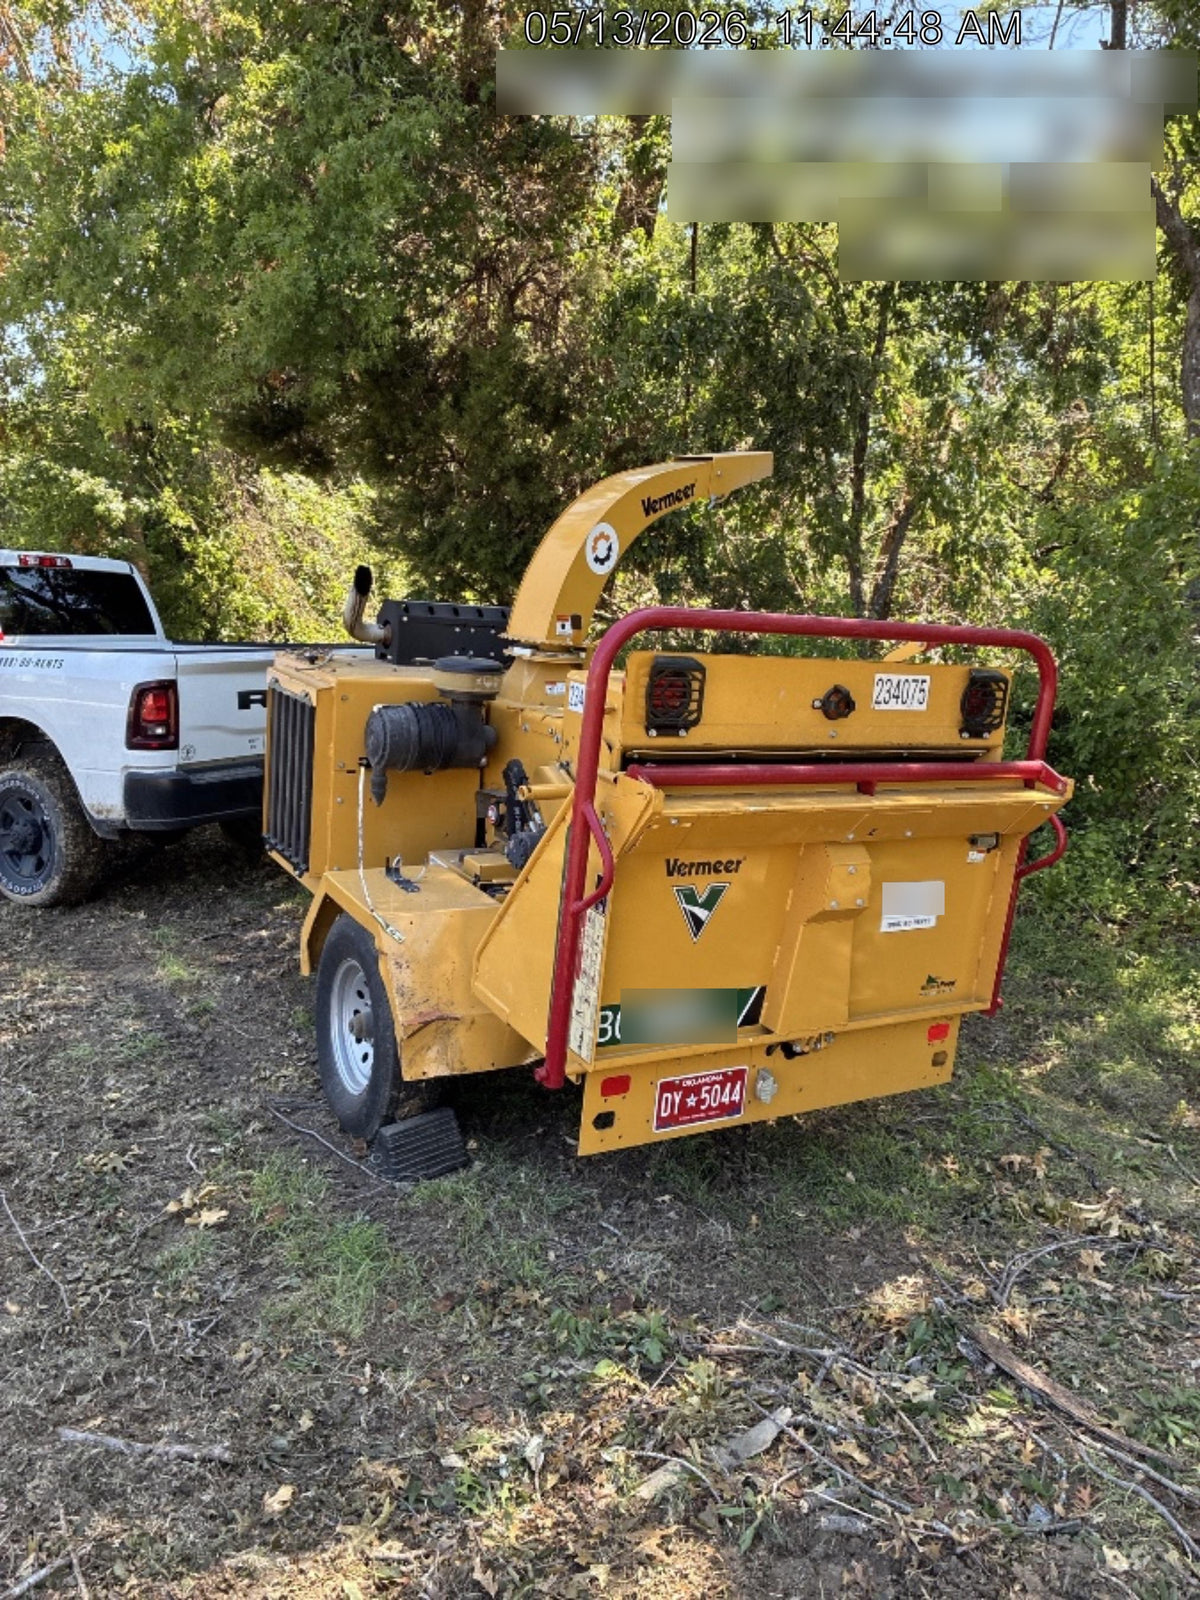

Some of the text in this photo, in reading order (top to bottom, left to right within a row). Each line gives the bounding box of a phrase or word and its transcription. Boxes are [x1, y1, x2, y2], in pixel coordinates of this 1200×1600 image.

[641, 482, 696, 518] Vermeer
[874, 678, 928, 706] 234075
[665, 857, 742, 877] Vermeer
[682, 1074, 724, 1087] OKLAHOMA
[661, 1080, 742, 1118] DY 5044
